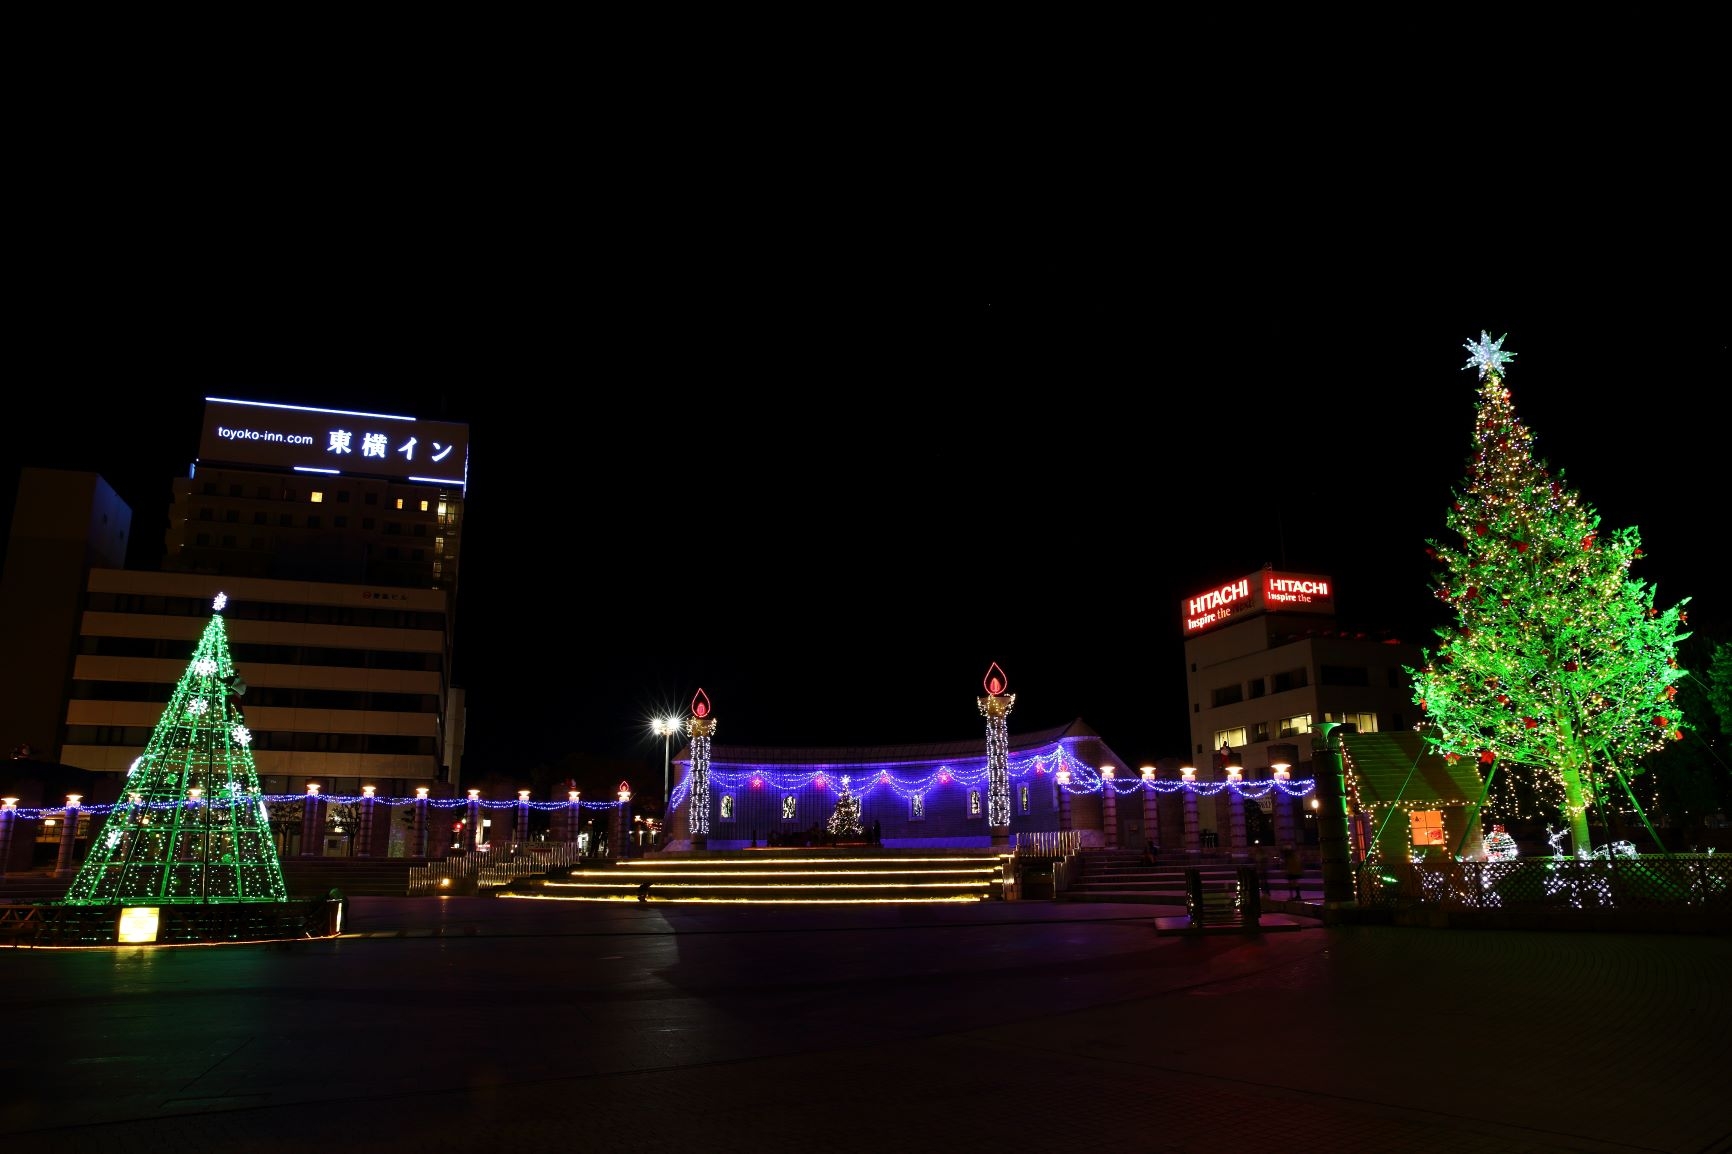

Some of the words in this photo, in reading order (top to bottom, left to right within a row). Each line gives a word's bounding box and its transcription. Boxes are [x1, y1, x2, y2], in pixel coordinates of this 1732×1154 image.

[217, 426, 313, 445] toyoko-inn.com
[327, 429, 452, 462] 東横イン
[1269, 578, 1328, 595] HITACHI
[1189, 579, 1249, 616] HITACHI
[1268, 591, 1297, 603] Inspire
[1297, 594, 1311, 603] the
[1188, 613, 1216, 629] Inspire
[1217, 607, 1231, 620] the
